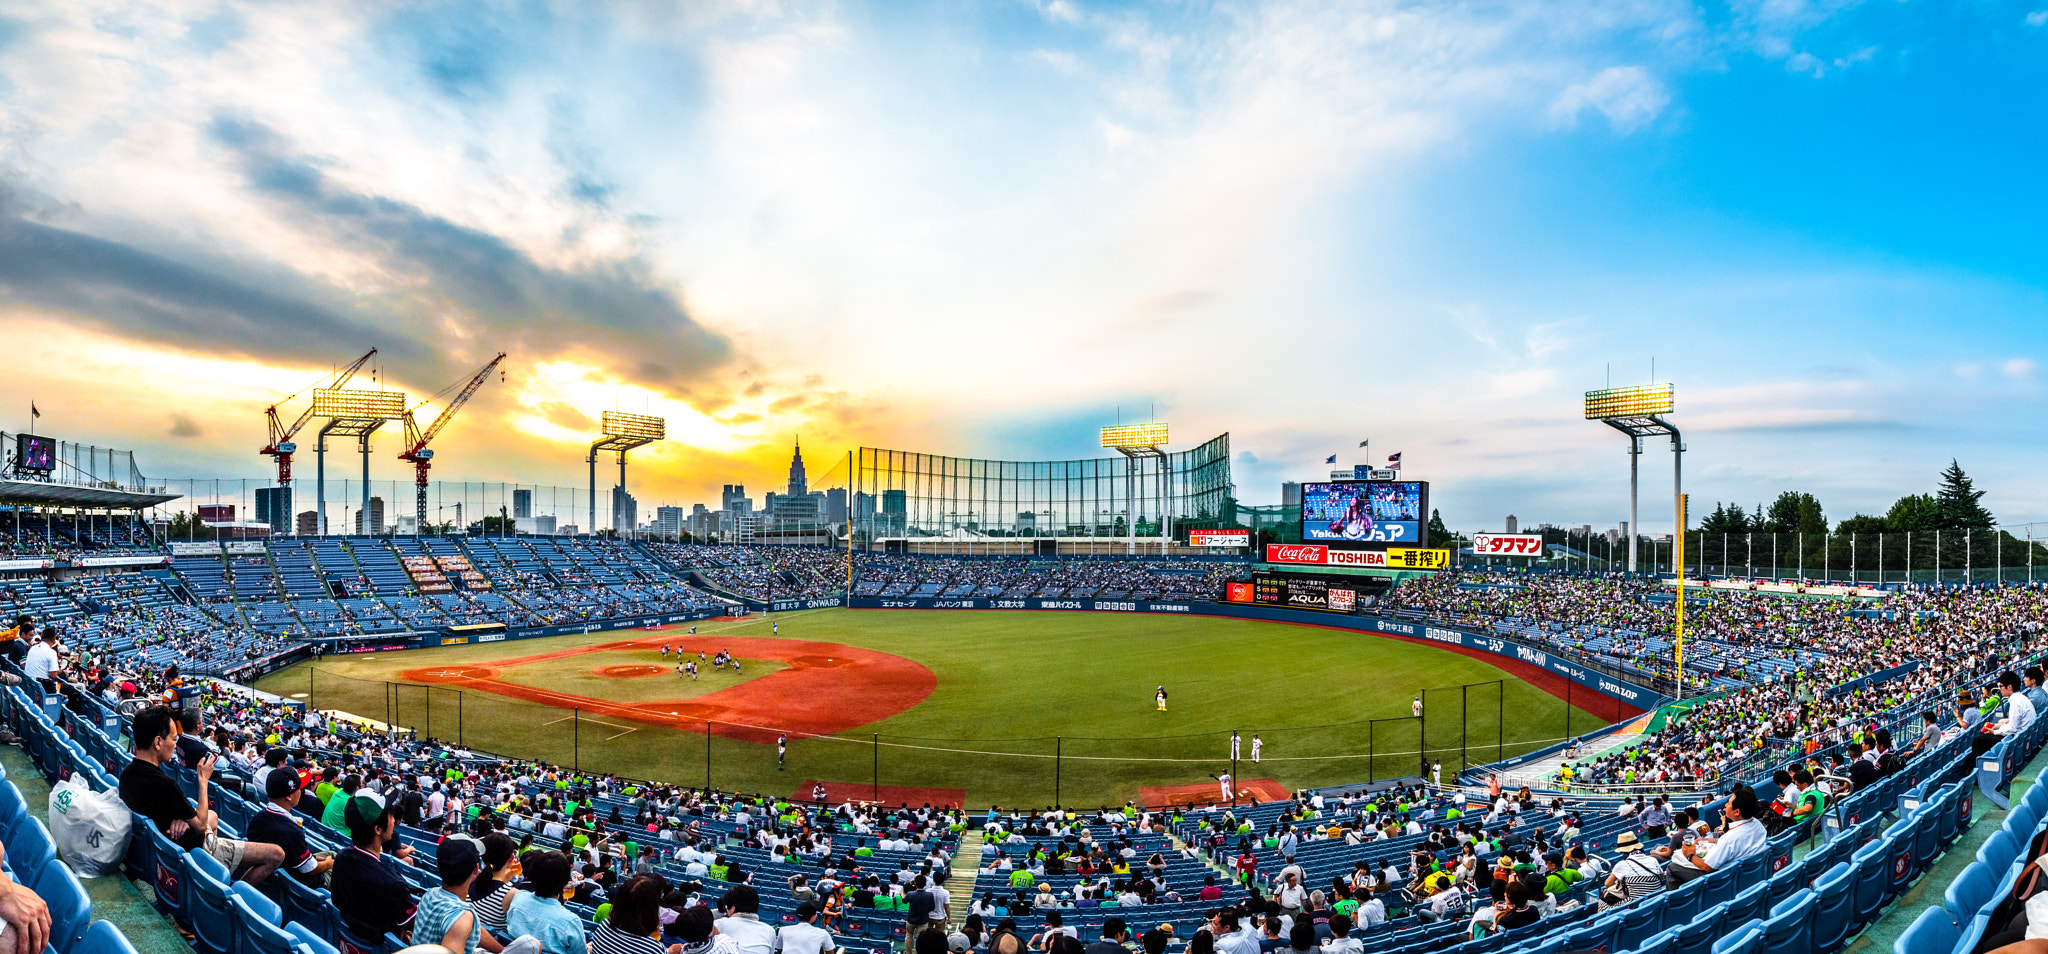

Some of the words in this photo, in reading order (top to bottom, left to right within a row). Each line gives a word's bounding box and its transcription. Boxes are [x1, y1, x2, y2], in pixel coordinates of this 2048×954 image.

[1207, 536, 1248, 545] フージャース
[1490, 538, 1541, 553] タフマン
[1277, 546, 1321, 561] Coca-Cola
[1329, 552, 1385, 565] TOSHIBA
[1390, 550, 1446, 567] 一番搾り
[807, 599, 840, 608] ONWARD
[1288, 594, 1327, 604] AQUA
[1604, 681, 1637, 700] DUNLOP
